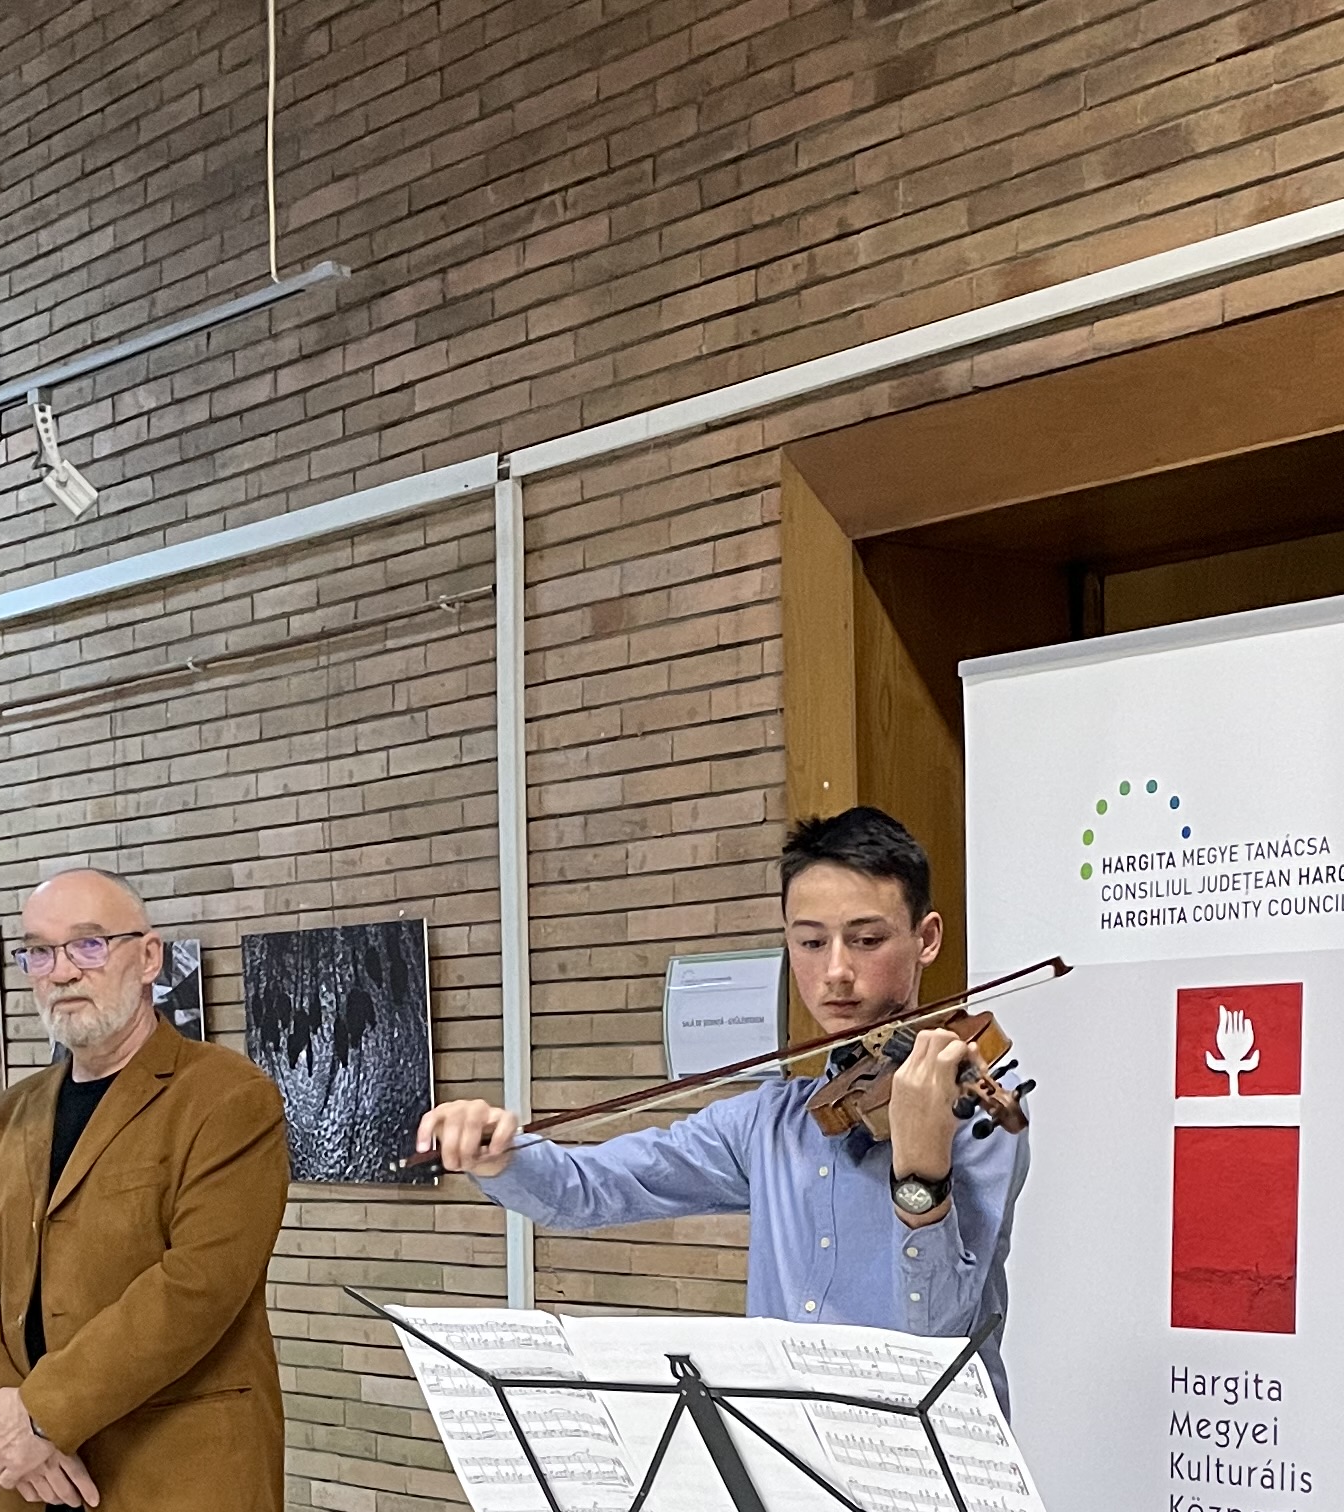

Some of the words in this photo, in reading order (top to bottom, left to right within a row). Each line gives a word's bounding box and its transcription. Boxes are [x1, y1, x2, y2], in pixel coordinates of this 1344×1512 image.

[1103, 852, 1176, 874] HARGITA
[1183, 845, 1238, 866] MEGYE
[1245, 834, 1330, 860] TANÁCSA
[1102, 879, 1192, 901] CONSILIUL
[1198, 869, 1290, 895] JUDEȚEAN
[1102, 907, 1187, 929] HARGHITA
[1193, 900, 1261, 922] COUNTY
[1172, 1366, 1281, 1405] Hargita
[1170, 1411, 1277, 1449] Megyei
[1171, 1452, 1311, 1493] Kulturális
